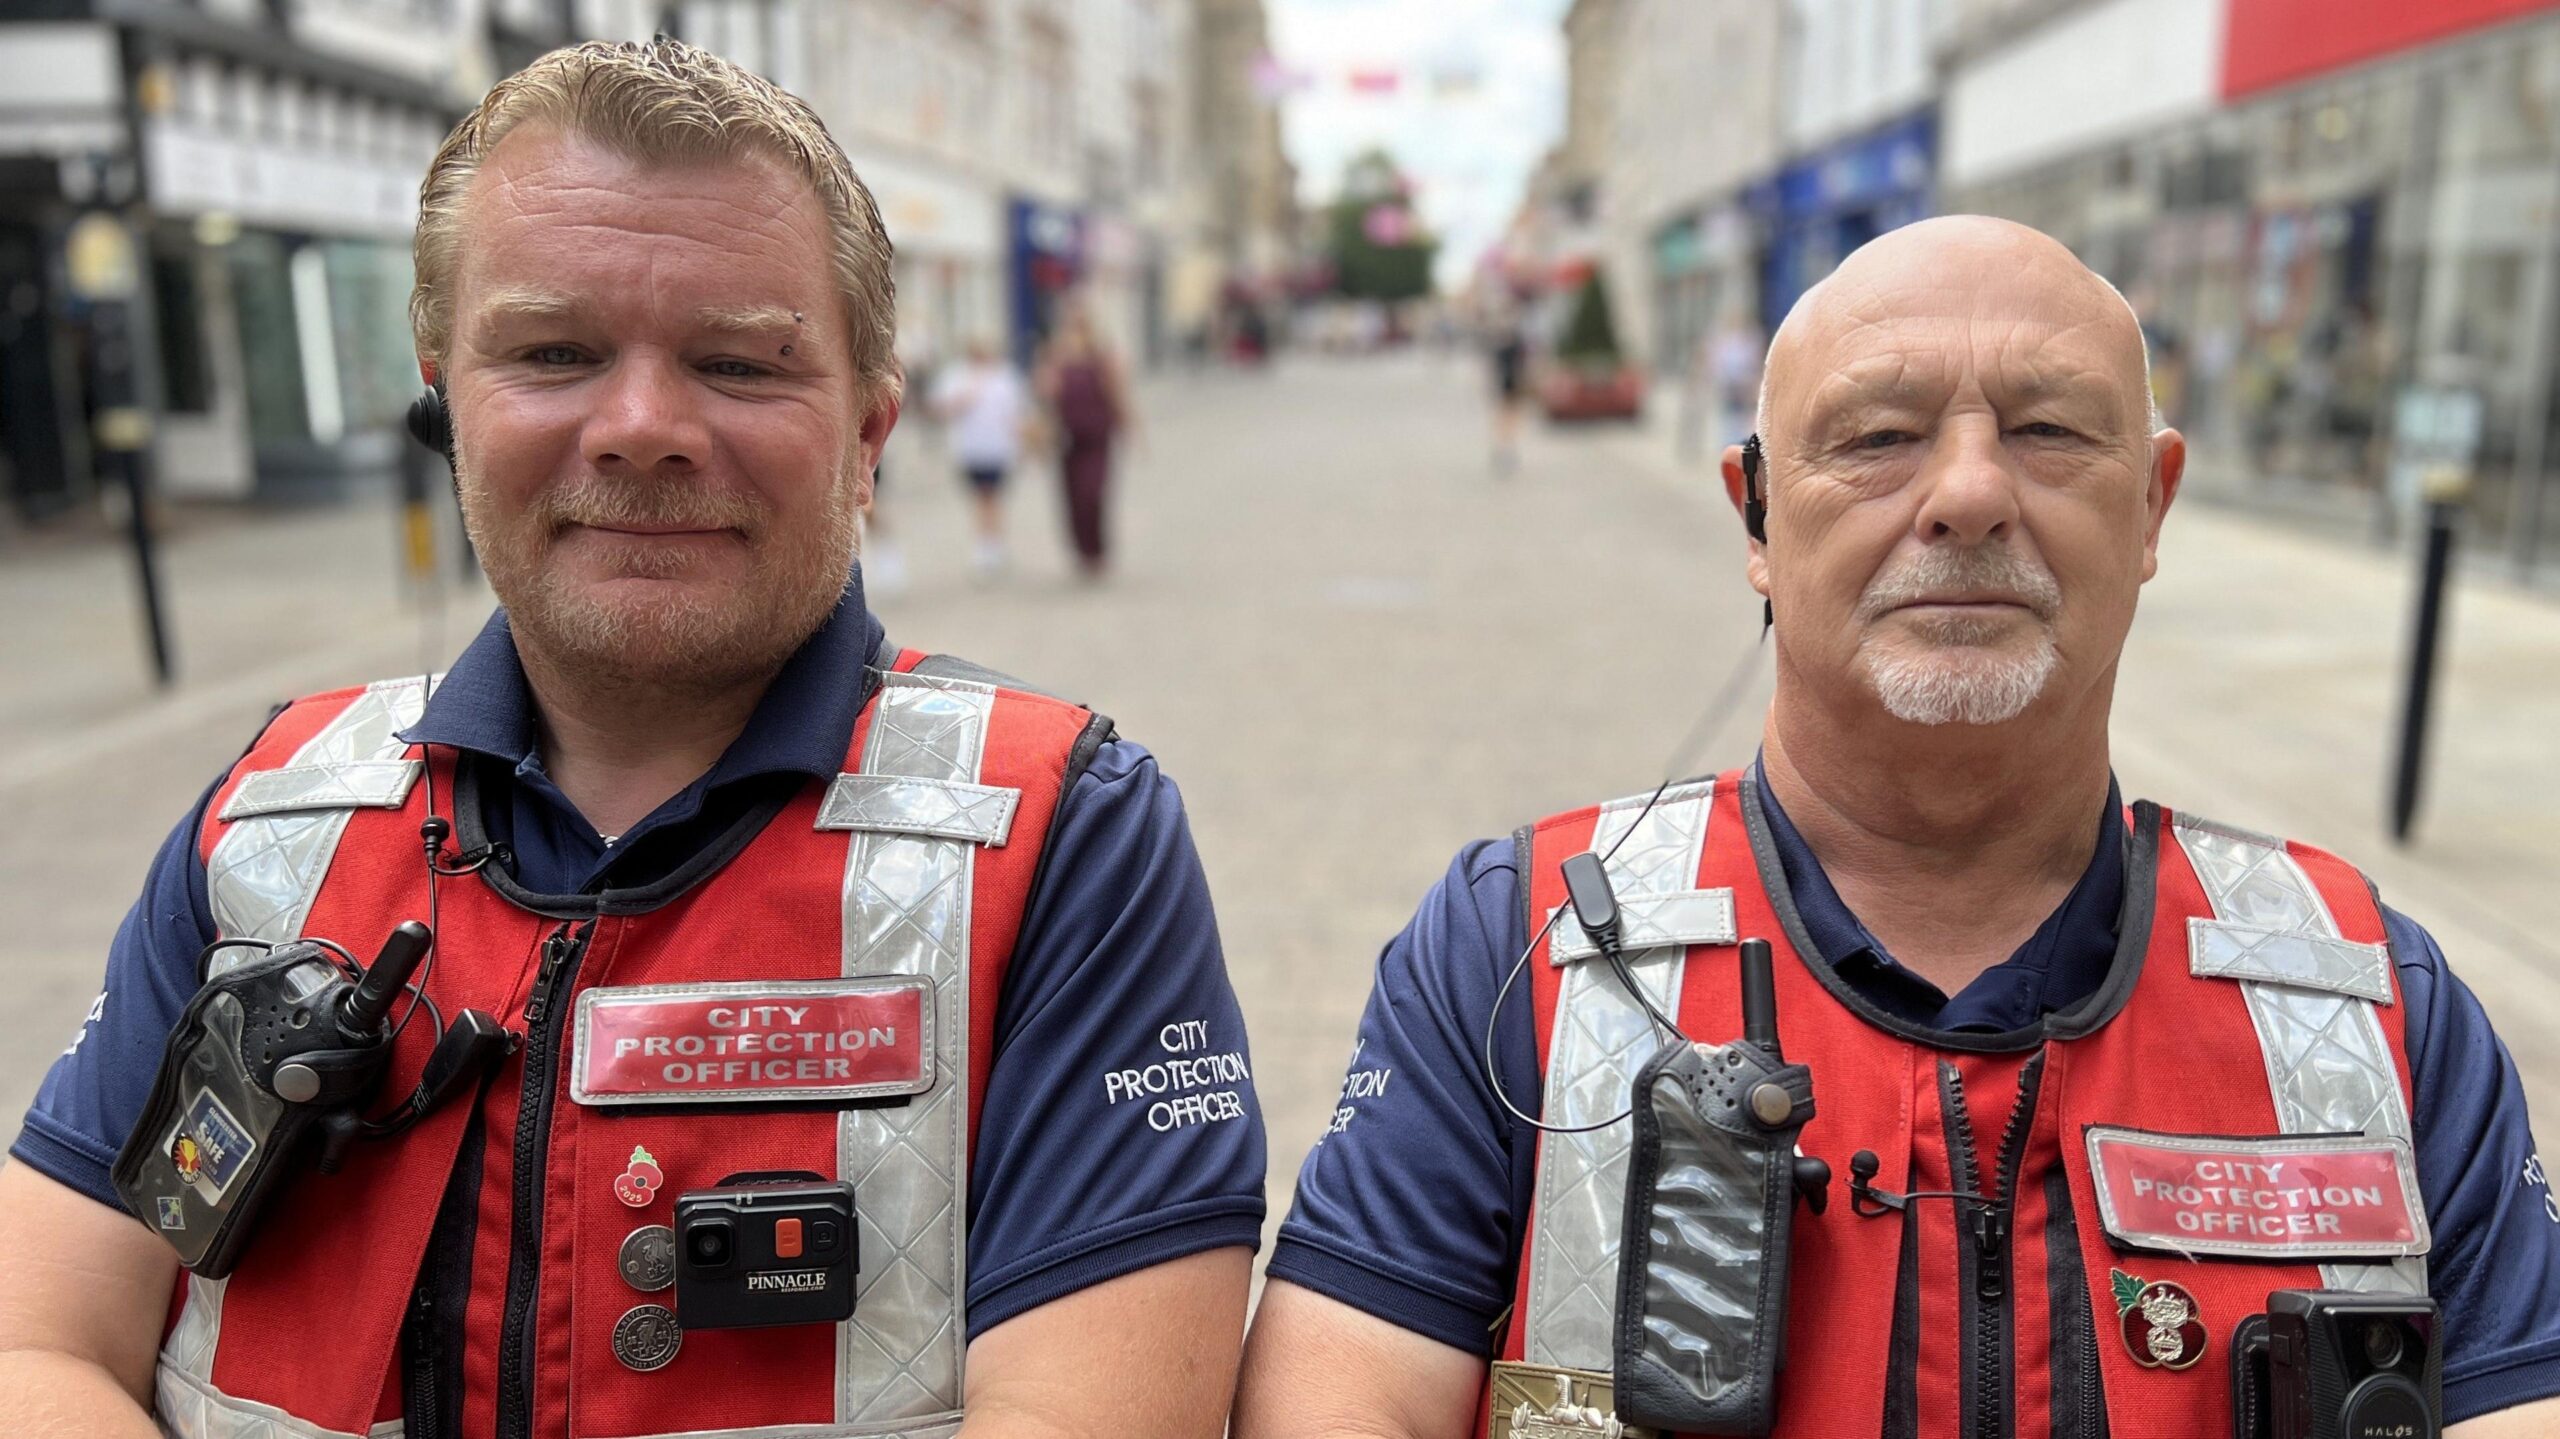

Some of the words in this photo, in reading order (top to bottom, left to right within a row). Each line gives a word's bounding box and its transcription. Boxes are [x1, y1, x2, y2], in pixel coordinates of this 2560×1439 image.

[707, 1006, 811, 1028] CITY
[614, 1026, 896, 1058] PROTECTION
[1160, 1020, 1208, 1053] CITY
[662, 1058, 851, 1083] OFFICER
[1104, 1052, 1249, 1105] PROTECTION
[1148, 1090, 1245, 1132] OFFICER
[195, 1122, 225, 1164] SAFE
[2195, 1161, 2284, 1183] CITY
[620, 1186, 643, 1202] 2025
[2133, 1178, 2383, 1210] PROTECTION
[2175, 1210, 2342, 1236] OFFICER
[748, 1273, 826, 1290] PINNACLE
[621, 1308, 646, 1327] NEVER
[2365, 1425, 2413, 1438] HALOS
